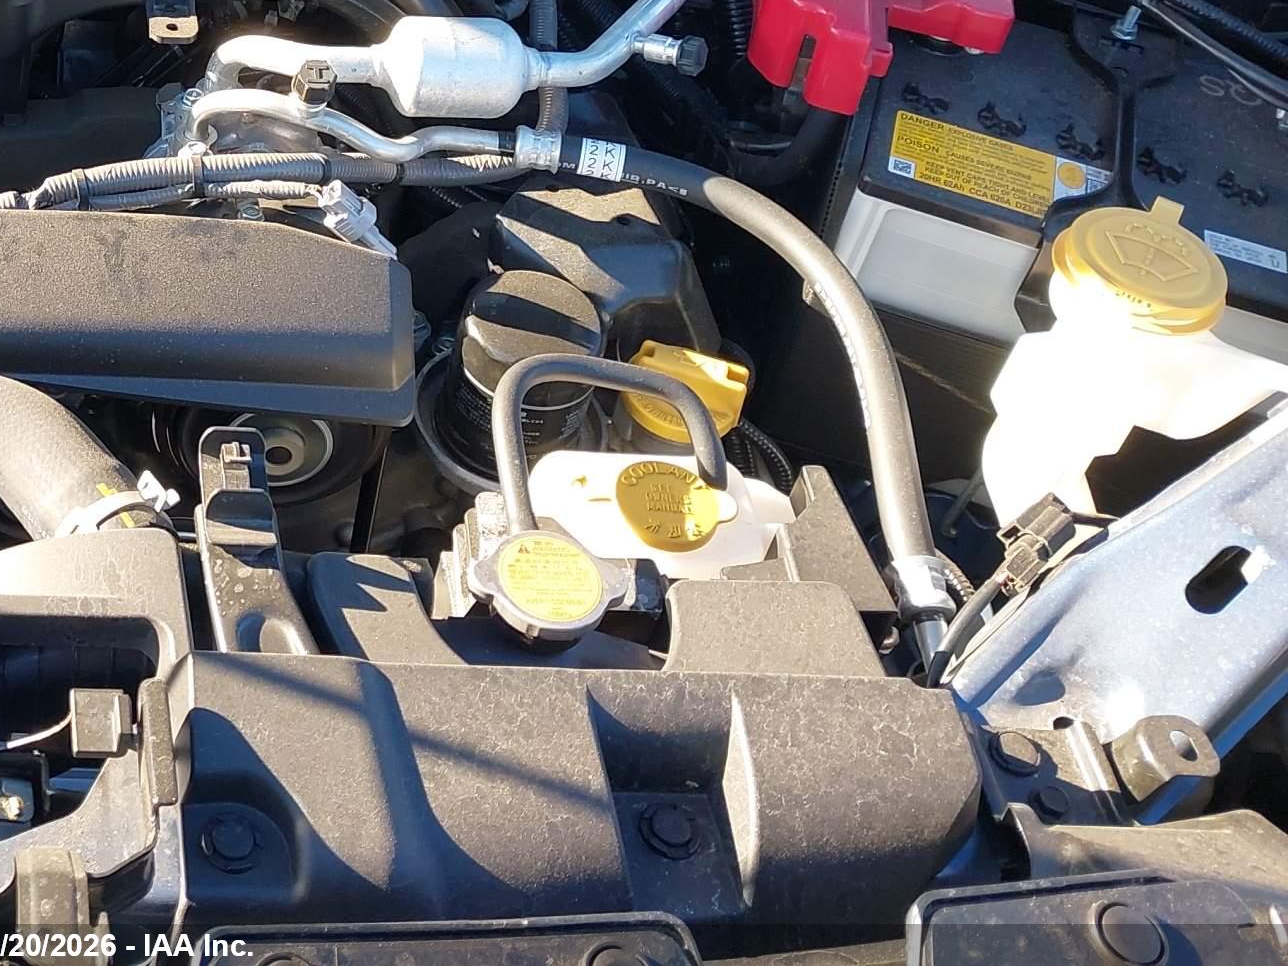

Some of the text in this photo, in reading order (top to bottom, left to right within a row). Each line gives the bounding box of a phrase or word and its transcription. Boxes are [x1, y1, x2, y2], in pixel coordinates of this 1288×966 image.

[900, 113, 944, 130] DANGER
[588, 143, 615, 160] 2 K
[897, 136, 939, 154] POISON
[587, 157, 612, 172] 2 K
[926, 161, 945, 172] KEEP
[947, 166, 965, 177] VENT
[924, 166, 943, 177] KEEP
[944, 171, 960, 182] OUT
[962, 176, 973, 185] OF
[919, 172, 942, 184] 20HR
[969, 187, 989, 199] CCA
